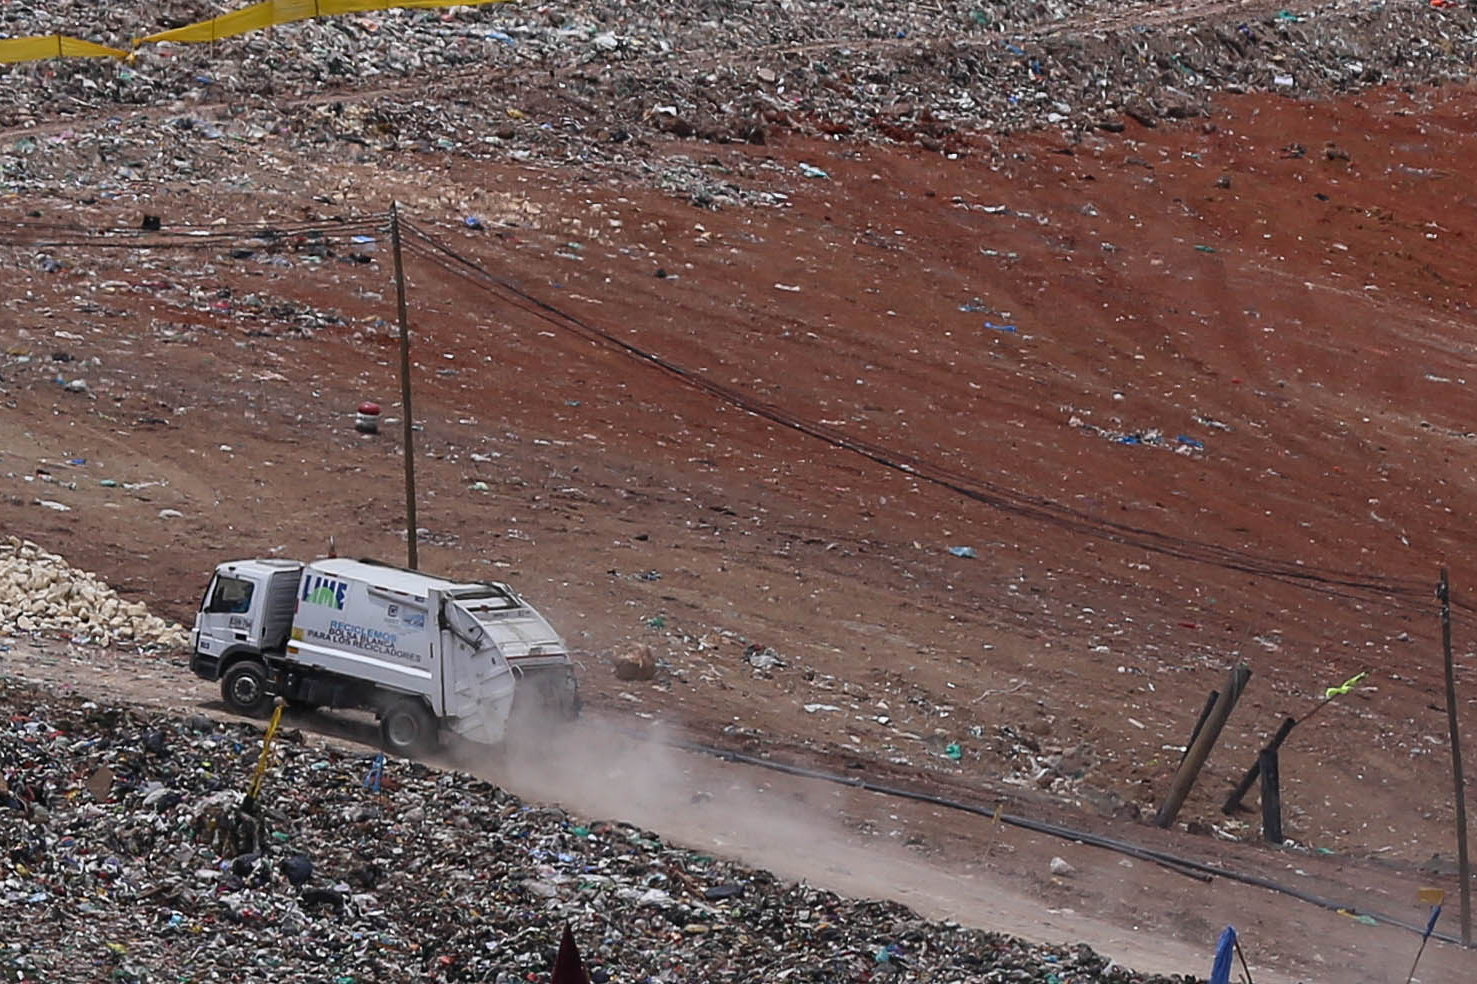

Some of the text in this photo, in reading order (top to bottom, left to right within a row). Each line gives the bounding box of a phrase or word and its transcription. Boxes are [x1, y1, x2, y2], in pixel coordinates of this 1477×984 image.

[302, 575, 347, 610] LIME
[329, 628, 395, 648] BOLSA BLANCA
[330, 620, 397, 642] RECICLEMOS
[308, 629, 421, 662] PARA LOS RECICLADORES
